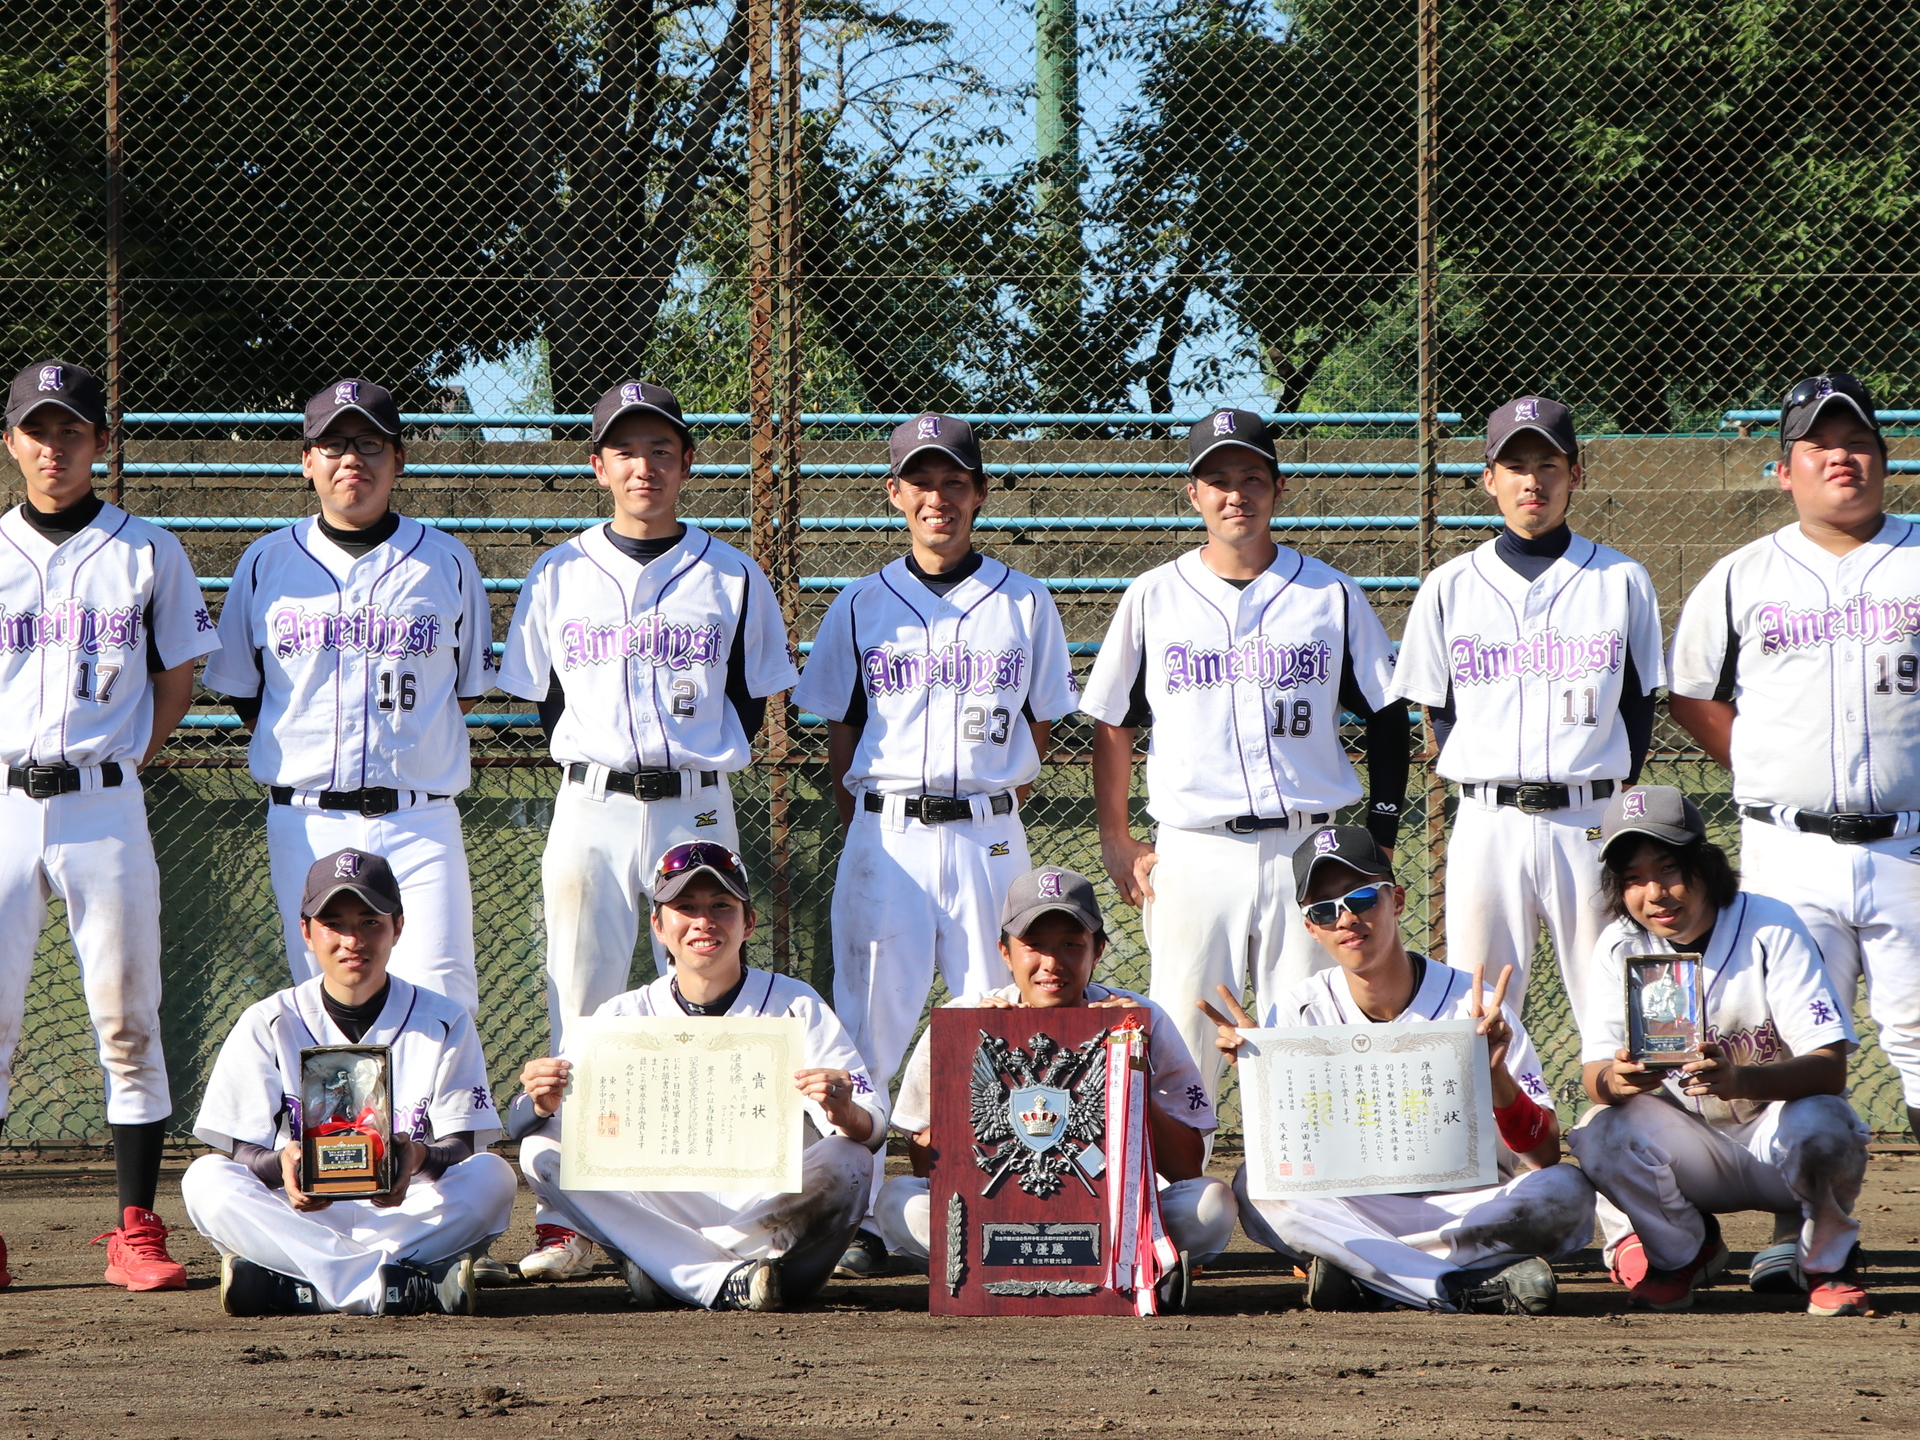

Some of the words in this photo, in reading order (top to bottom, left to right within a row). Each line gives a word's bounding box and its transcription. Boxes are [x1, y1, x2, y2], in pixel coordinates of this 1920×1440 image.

[38, 366, 64, 393] A
[335, 381, 360, 403] A
[620, 382, 645, 409] A
[916, 415, 941, 439] A
[1212, 411, 1237, 437] A
[1514, 399, 1539, 422] A
[0, 597, 142, 655] methyst
[271, 606, 441, 660] Amethyst
[560, 612, 723, 671] Amethyst
[861, 641, 1027, 698] Amethyst
[1162, 634, 1332, 694] Amethyst
[1449, 626, 1624, 688] Amethyst
[1874, 652, 1920, 695] 19
[75, 660, 122, 703] 17
[376, 669, 417, 713] 16
[670, 678, 698, 719] 2
[960, 705, 1011, 747] 23
[1271, 698, 1314, 739] 18
[1560, 686, 1599, 727] 11
[1622, 791, 1648, 821] A
[1315, 829, 1341, 855] A
[334, 852, 361, 879] A
[1037, 872, 1064, 900] A
[752, 1072, 767, 1119] 賞状
[1420, 1061, 1435, 1098] 準優勝
[1443, 1079, 1462, 1125] 賞状
